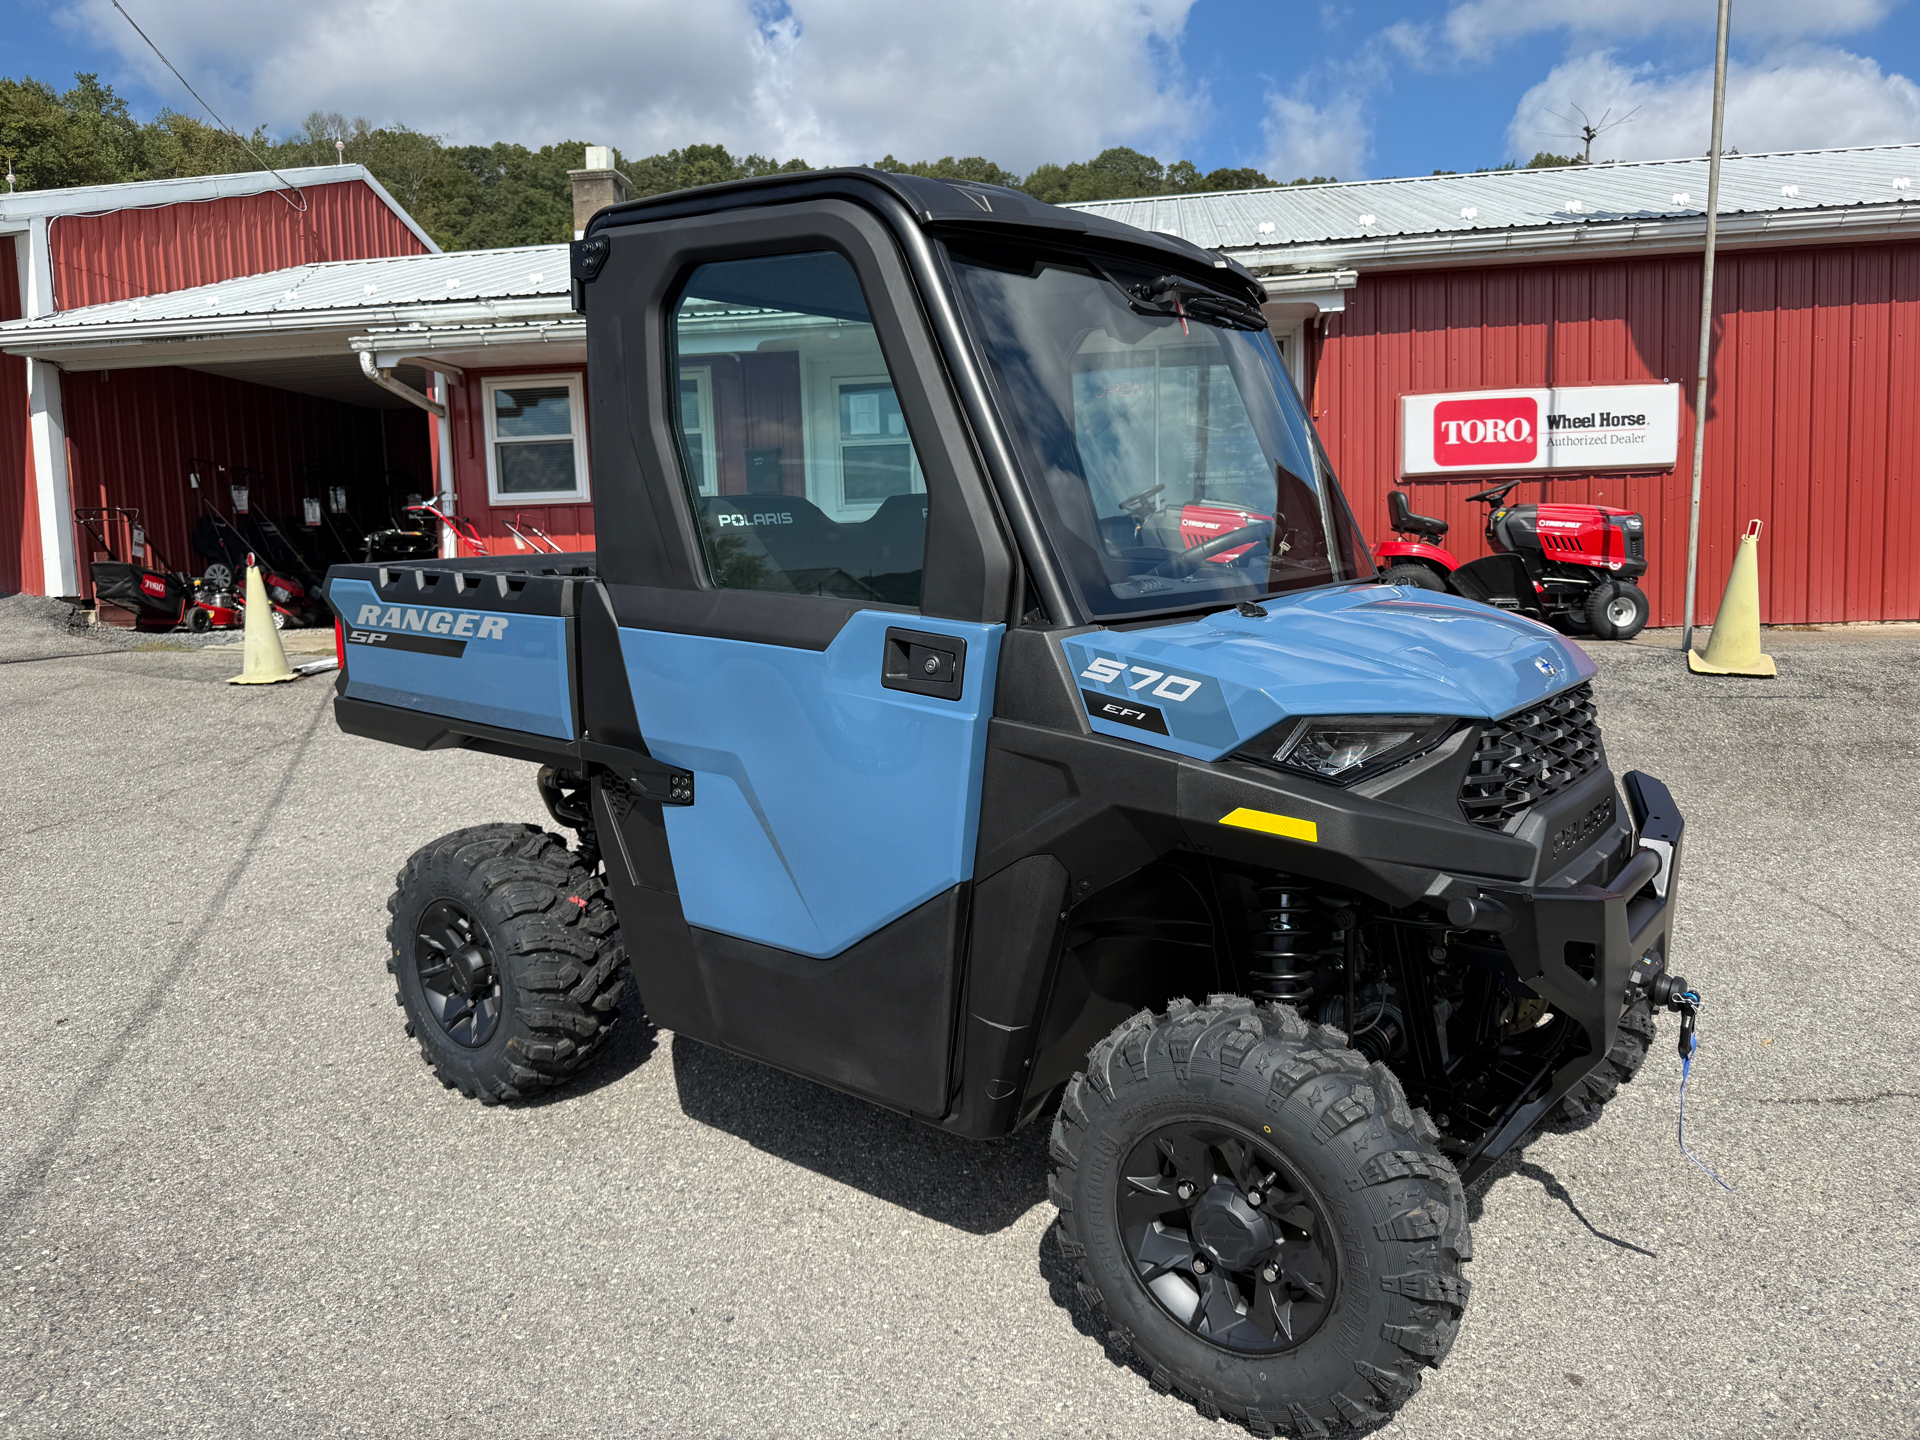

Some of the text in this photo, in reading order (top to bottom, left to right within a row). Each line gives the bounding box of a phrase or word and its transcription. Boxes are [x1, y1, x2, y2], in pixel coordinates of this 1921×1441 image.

[1093, 382, 1145, 399] OPEN
[1547, 412, 1646, 429] Wheel Horse
[1441, 417, 1531, 445] TORO
[1546, 433, 1646, 447] Authorized Dealer
[717, 512, 794, 527] POLARIS
[1545, 520, 1582, 529] TROY-BILT
[144, 579, 165, 593] TORO
[356, 604, 510, 641] RANGER
[348, 630, 389, 645] SP
[1080, 656, 1202, 702] 570
[1102, 703, 1147, 721] EFI
[1552, 796, 1610, 860] POLARIS
[1087, 1156, 1119, 1274] PRO ARMOR
